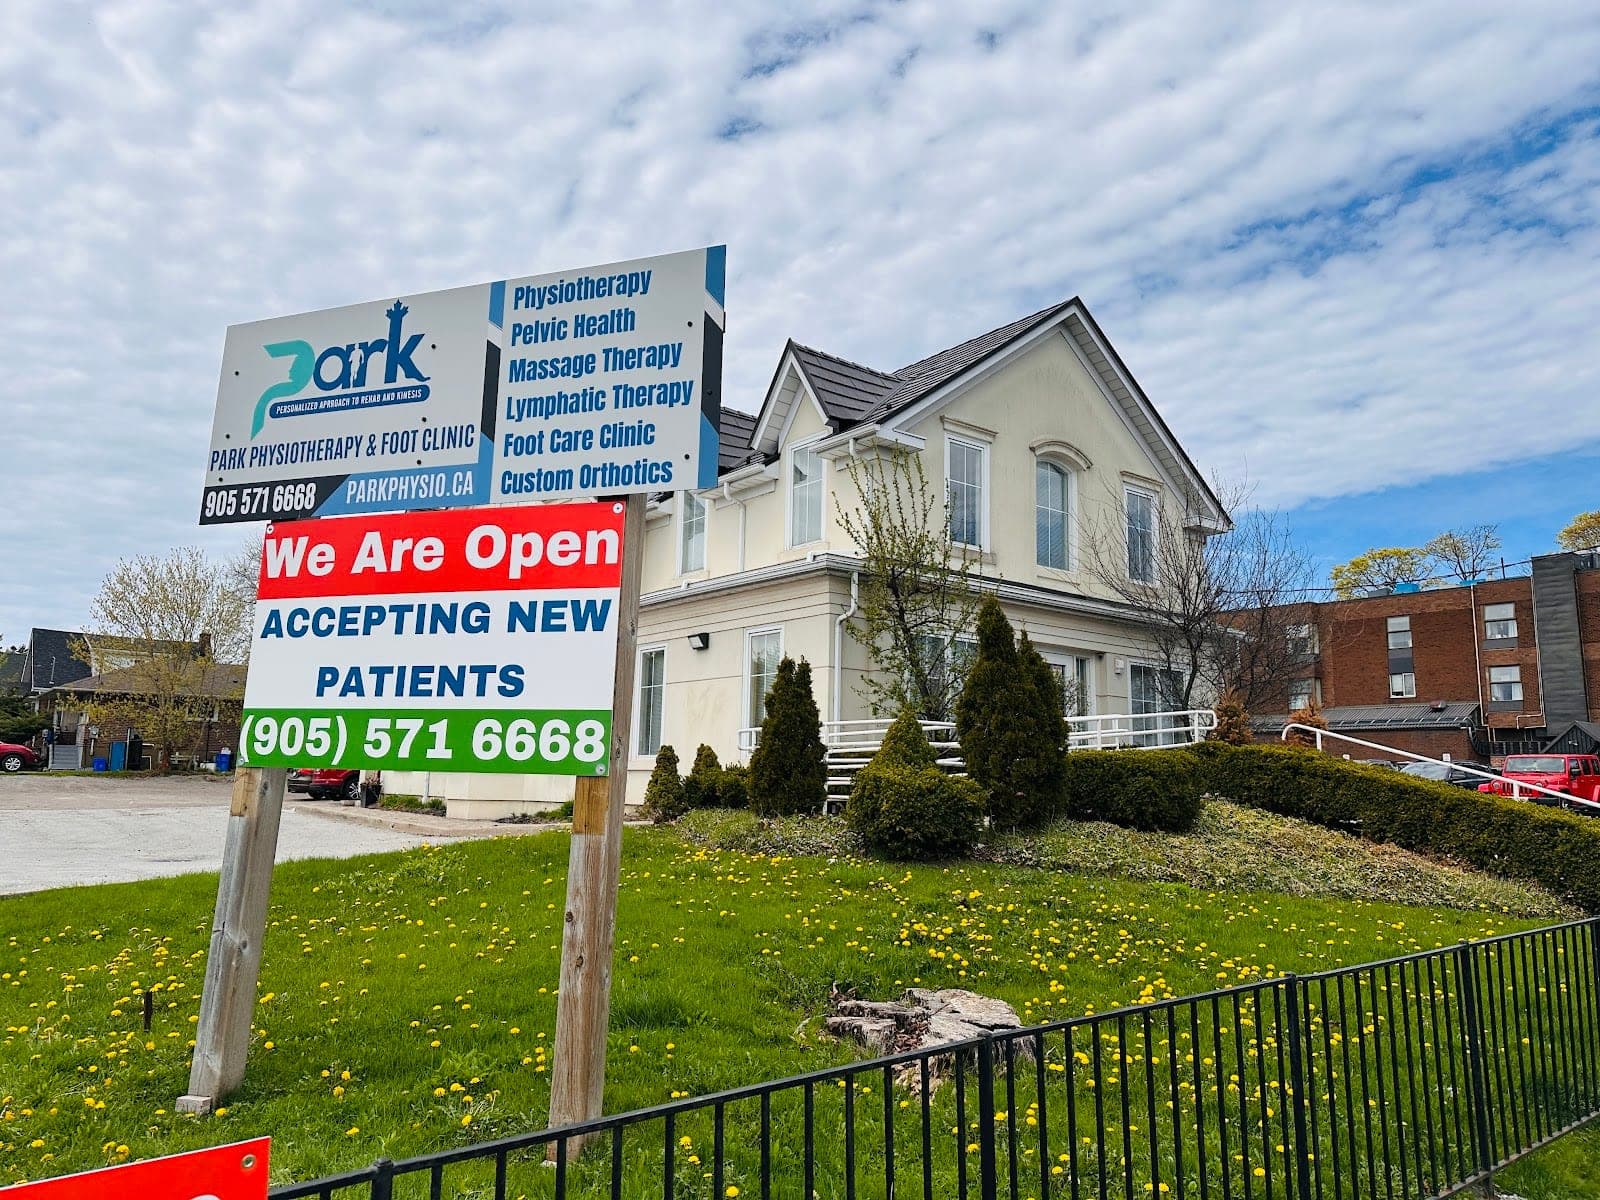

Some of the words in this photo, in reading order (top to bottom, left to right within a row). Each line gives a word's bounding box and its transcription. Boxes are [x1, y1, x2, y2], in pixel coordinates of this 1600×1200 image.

[513, 270, 652, 310] Physiotherapy
[511, 317, 568, 346] Pelvic
[573, 307, 636, 339] Health
[250, 299, 431, 441] Park
[508, 352, 596, 383] Massage
[602, 342, 682, 372] Therapy
[276, 402, 318, 415] PERSONALIZED
[351, 396, 360, 406] TO
[360, 392, 381, 404] REHAB
[382, 390, 396, 402] AND
[396, 388, 422, 400] KINESIS
[506, 387, 607, 422] Lymphatic
[612, 380, 694, 410] Therapy
[210, 447, 246, 472] PARK
[250, 435, 363, 468] PHYSIOTHERAPY
[366, 434, 377, 457] &
[381, 429, 419, 454] FOOT
[422, 424, 475, 450] CLINIC
[503, 430, 544, 457] Foot
[549, 427, 594, 453] Care
[600, 420, 656, 449] Clinic
[346, 470, 473, 504] PARKPHYSIO.CA
[501, 468, 573, 494] Custom
[579, 458, 673, 489] Orthotics
[205, 489, 236, 518] 905
[240, 485, 269, 515] 571
[273, 482, 317, 512] 6668
[265, 536, 336, 579] We
[350, 531, 445, 574] Are
[465, 524, 619, 579] Open
[260, 602, 491, 639] ACCEPTING
[507, 599, 612, 633] NEW
[316, 664, 525, 698] PATIENTS
[239, 715, 347, 766] (905)
[363, 718, 452, 759] 571
[472, 718, 605, 763] 6668
